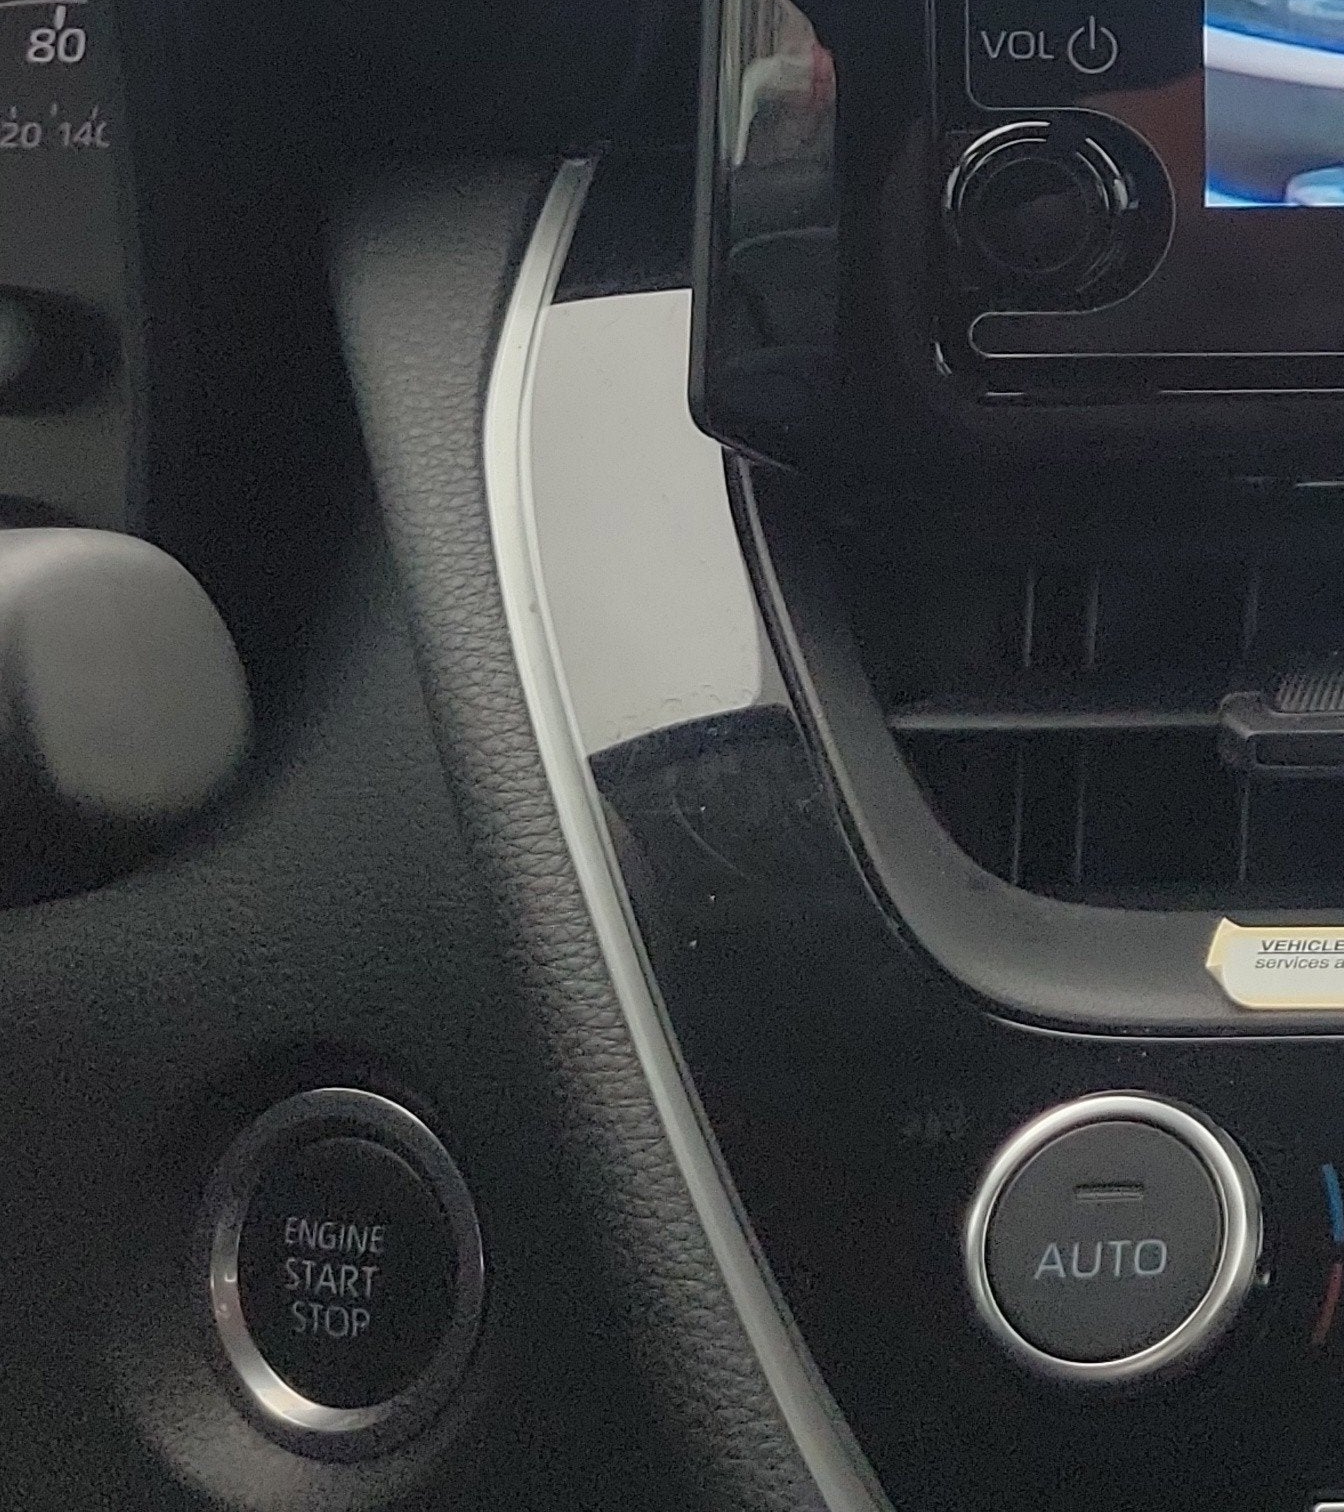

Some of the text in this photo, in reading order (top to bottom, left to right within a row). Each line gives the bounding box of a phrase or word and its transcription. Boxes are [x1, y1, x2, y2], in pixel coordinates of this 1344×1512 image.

[27, 27, 87, 63] 80
[980, 30, 1055, 60] VOL
[0, 121, 43, 148] 20
[1255, 956, 1329, 969] services
[284, 1216, 386, 1256] ENGINE
[283, 1257, 379, 1298] START
[1033, 1238, 1168, 1280] AUTO
[290, 1300, 370, 1339] STOP
